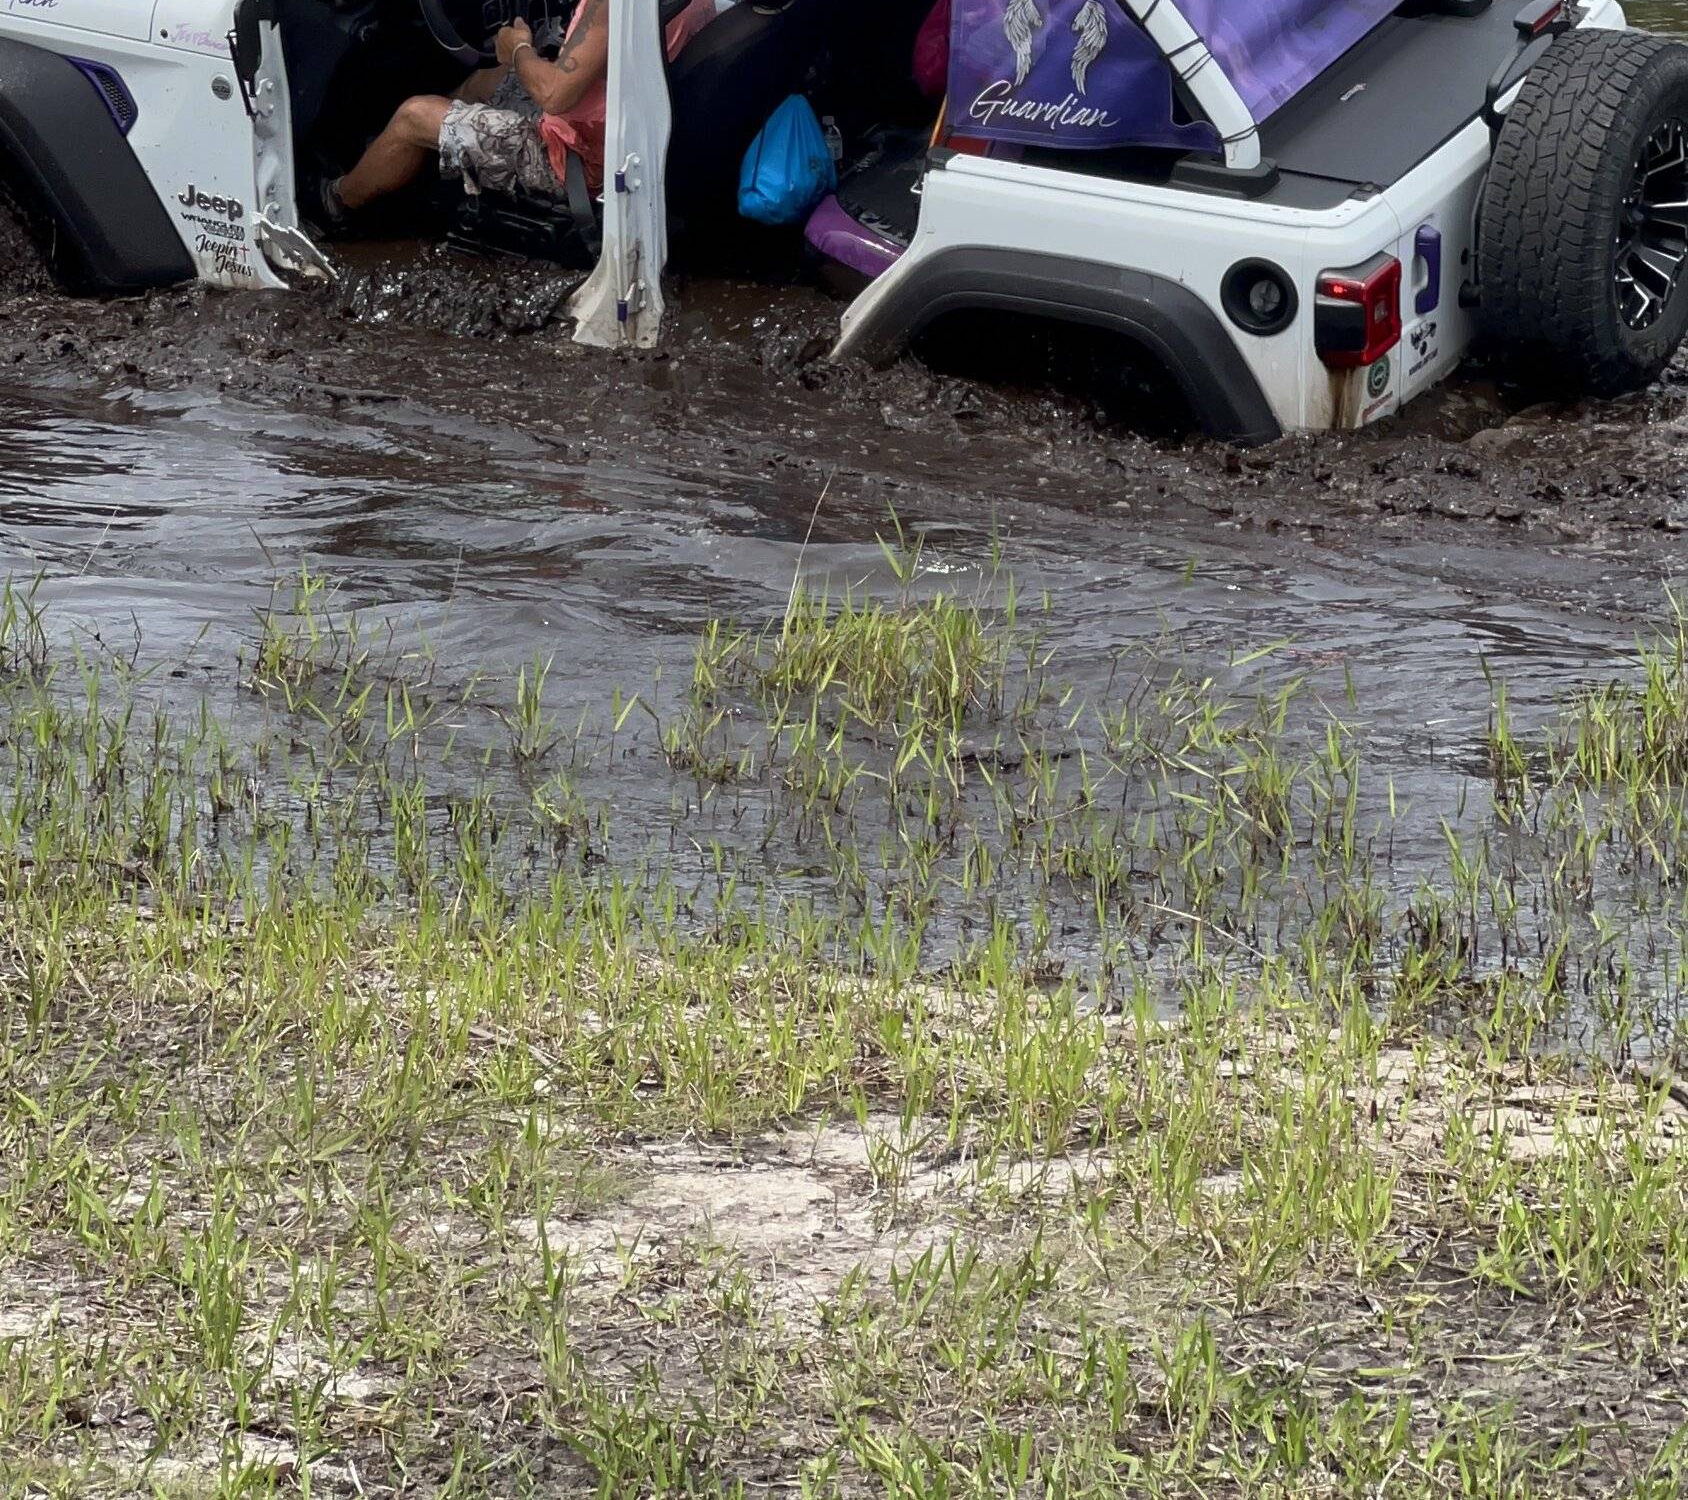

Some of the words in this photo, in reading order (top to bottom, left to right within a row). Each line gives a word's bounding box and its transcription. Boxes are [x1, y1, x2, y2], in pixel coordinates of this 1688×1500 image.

[969, 79, 1121, 130] Guardian
[178, 182, 244, 222] Jeep
[215, 255, 252, 277] Jesus
